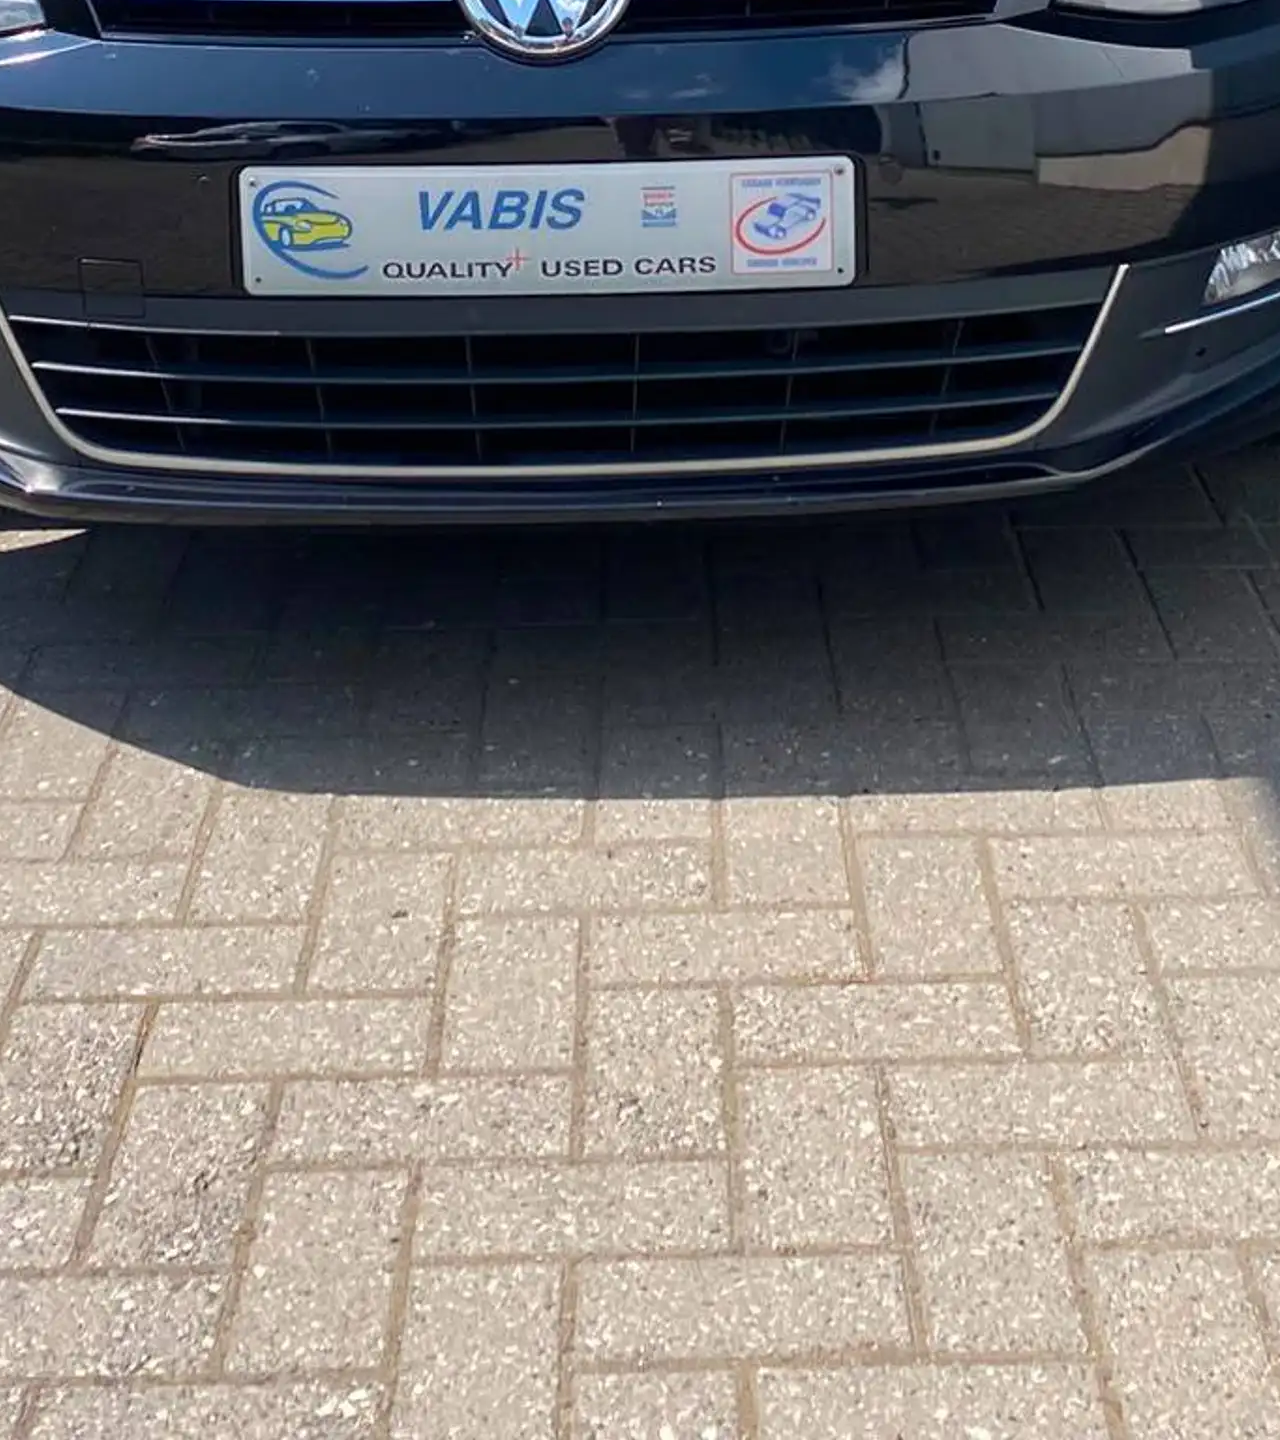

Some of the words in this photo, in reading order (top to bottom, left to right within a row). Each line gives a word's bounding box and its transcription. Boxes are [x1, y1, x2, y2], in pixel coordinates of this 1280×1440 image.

[418, 188, 586, 231] VABIS
[382, 259, 514, 280] QUALITY
[541, 259, 624, 278] USED
[634, 256, 718, 276] CARS
